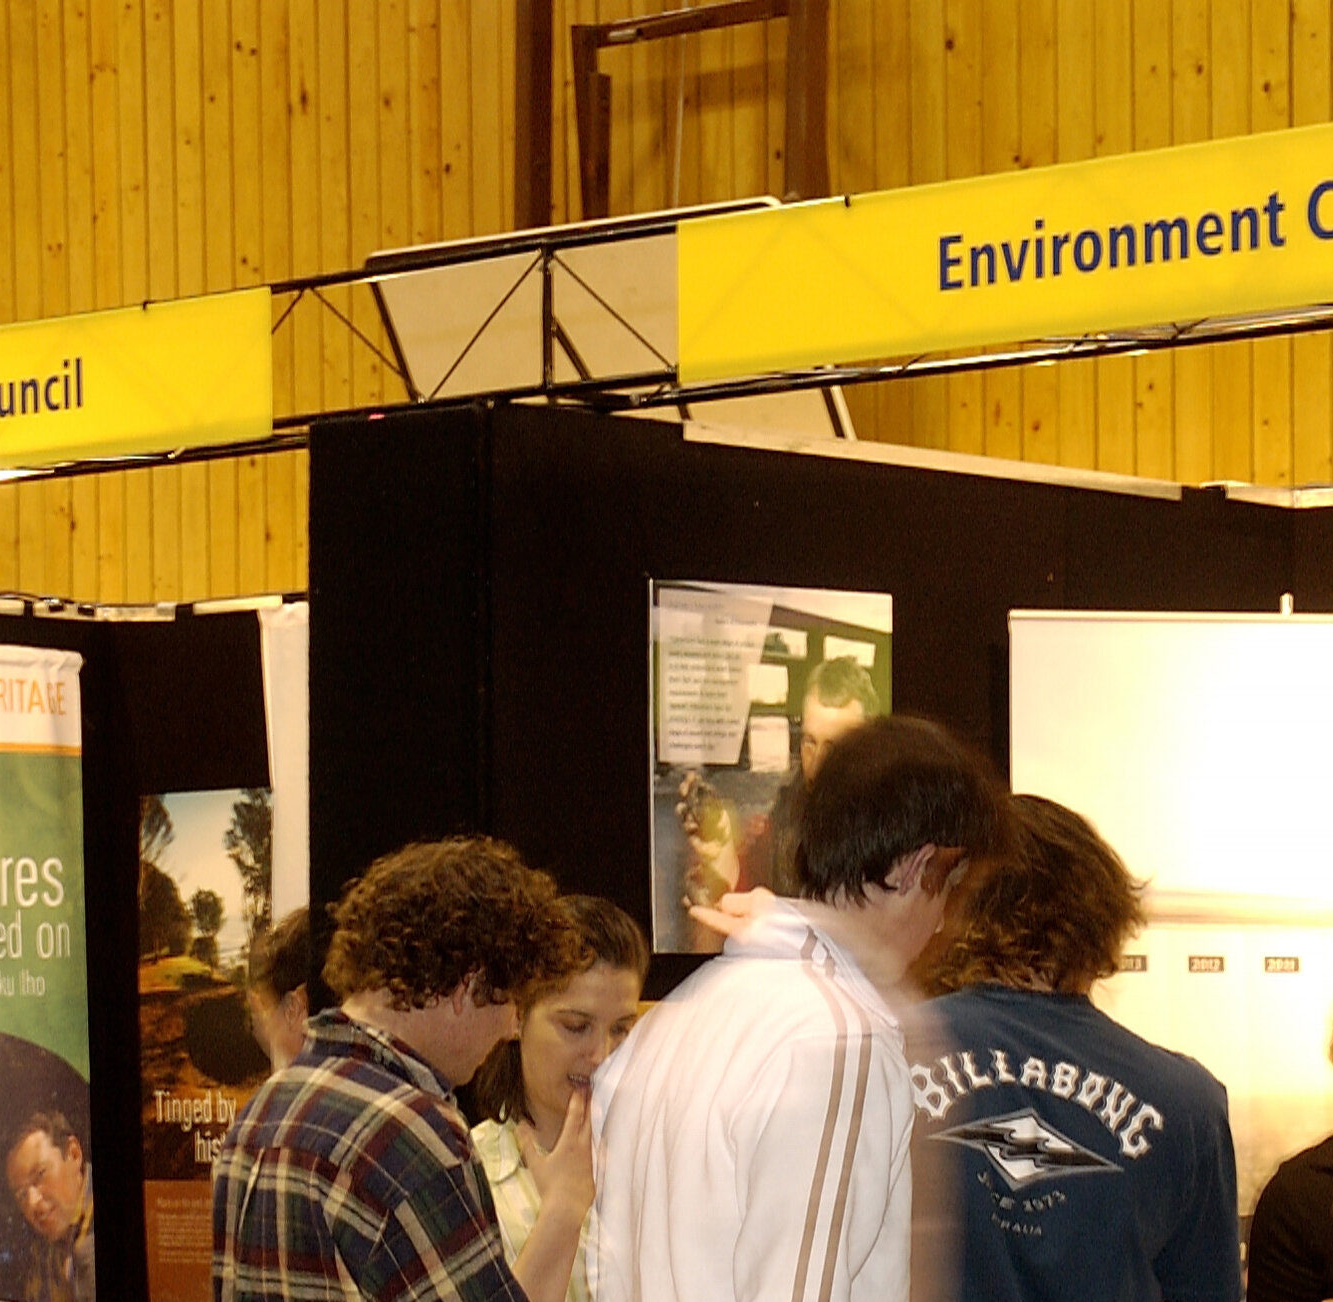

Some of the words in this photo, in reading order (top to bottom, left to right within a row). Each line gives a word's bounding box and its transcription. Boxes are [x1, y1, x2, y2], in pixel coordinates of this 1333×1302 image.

[938, 191, 1286, 292] Environment
[35, 921, 71, 960] on
[154, 1090, 212, 1133] Tinged
[216, 1090, 238, 1131] by
[910, 1048, 1164, 1160] BILLABONG
